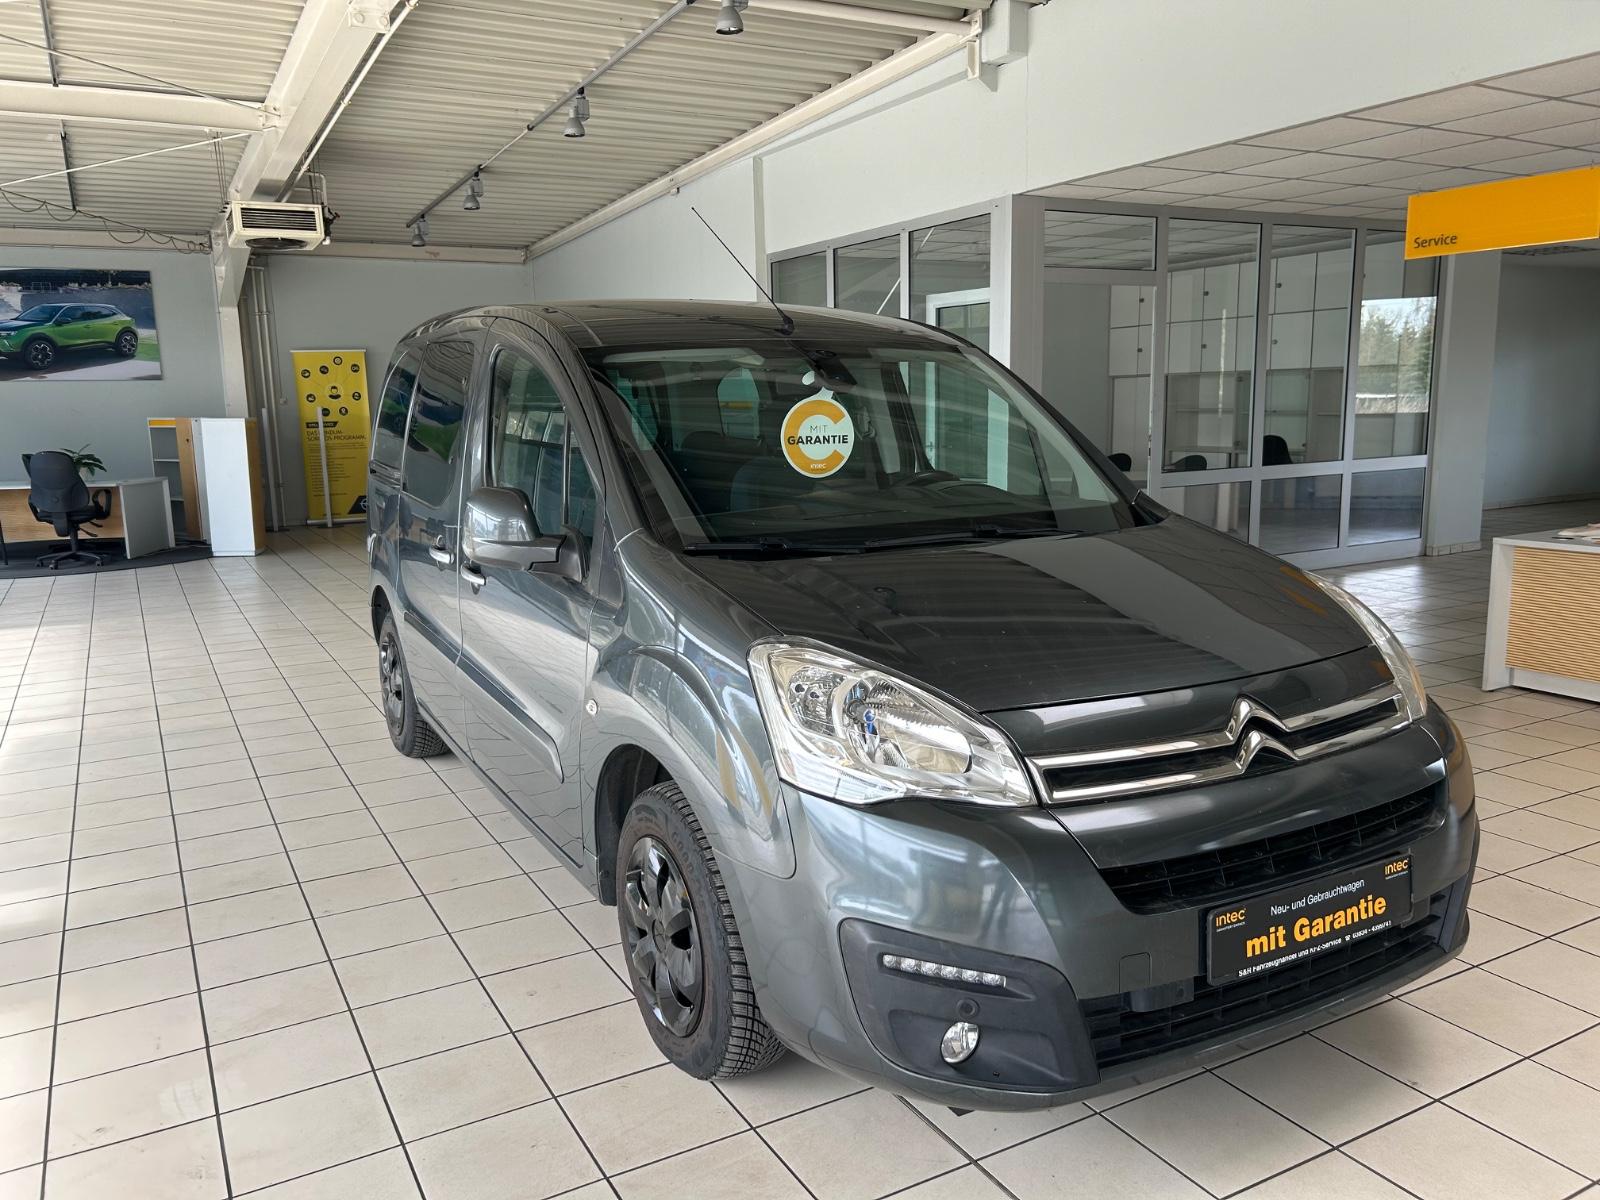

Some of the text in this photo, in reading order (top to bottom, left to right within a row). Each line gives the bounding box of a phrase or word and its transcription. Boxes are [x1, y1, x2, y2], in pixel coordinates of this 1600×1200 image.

[1413, 233, 1458, 249] Service
[809, 424, 828, 433] MIT
[787, 434, 849, 445] GARANTIE
[1385, 859, 1409, 875] intec
[1270, 878, 1365, 916] Neu- und Gebrauchtwagen
[1216, 909, 1246, 927] intec
[1246, 894, 1387, 958] mit Garantie
